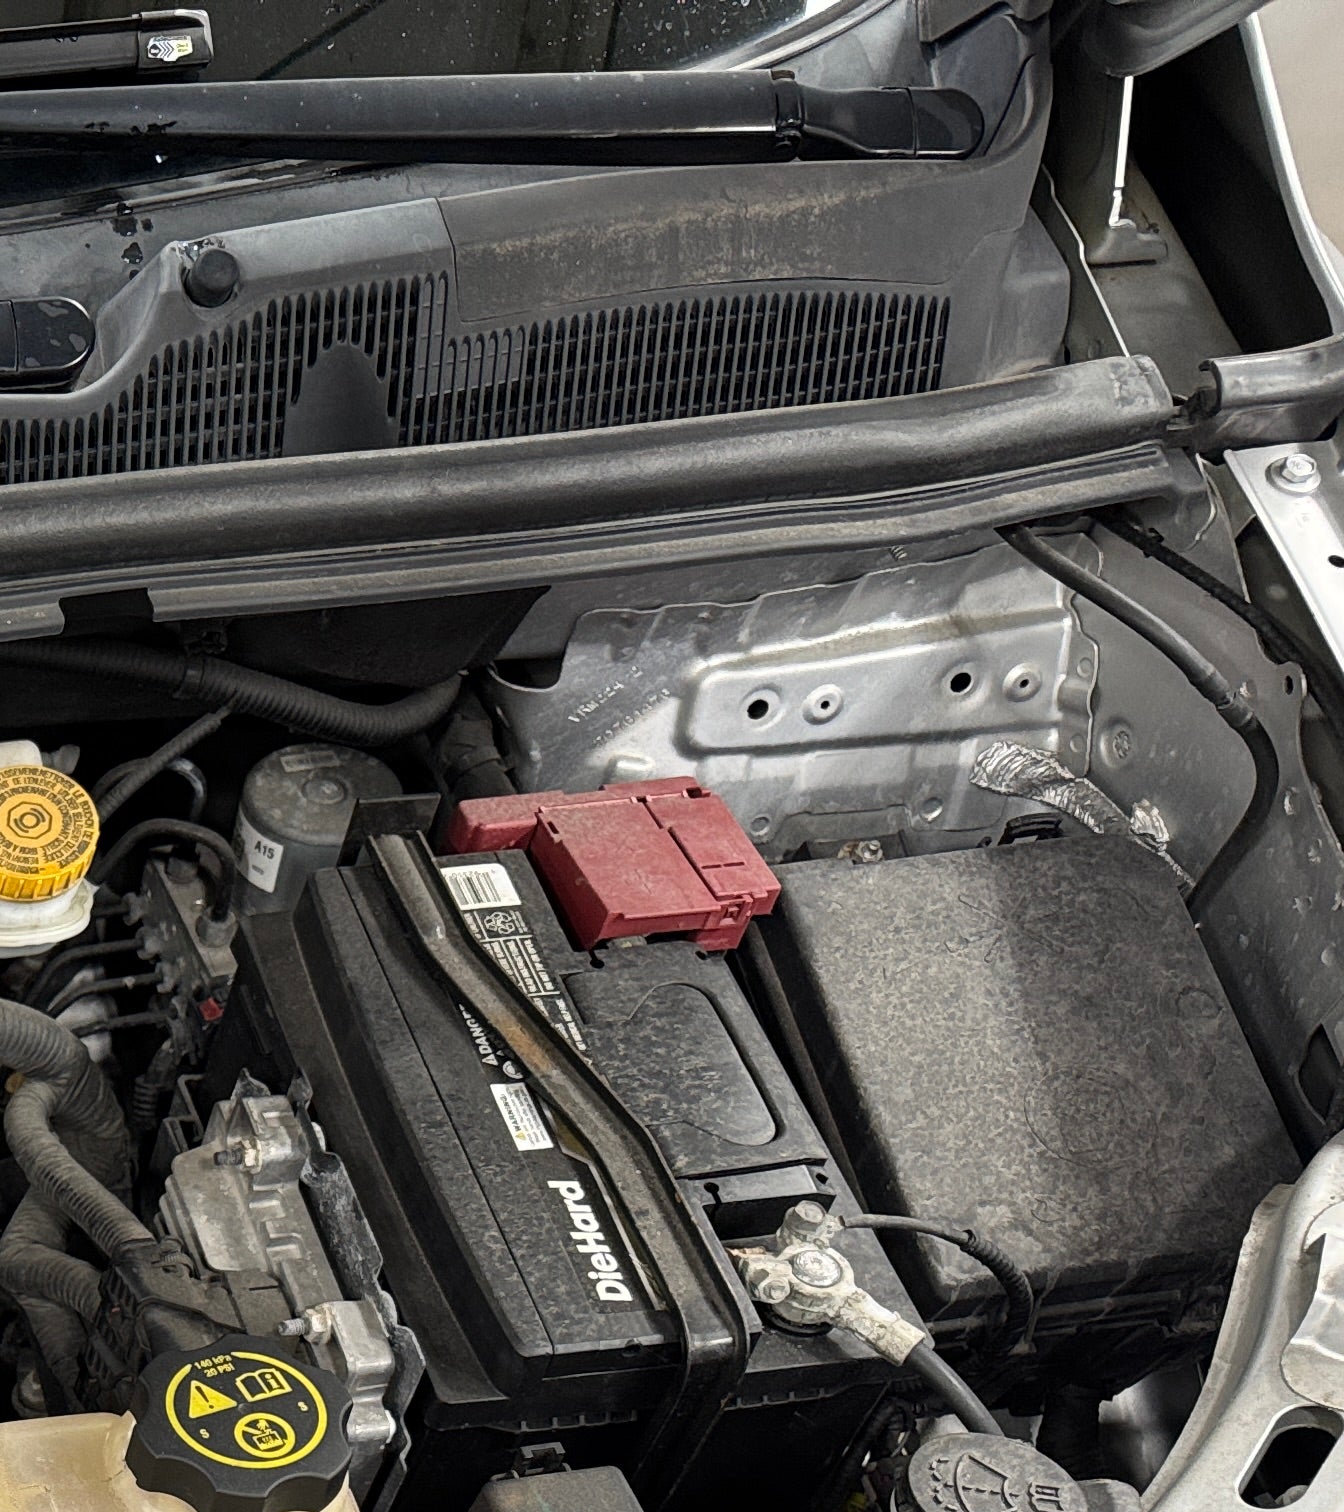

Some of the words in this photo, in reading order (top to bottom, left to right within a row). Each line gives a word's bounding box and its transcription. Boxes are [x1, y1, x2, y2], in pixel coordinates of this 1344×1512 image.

[254, 840, 275, 859] A15
[546, 1180, 633, 1301] DieHard
[194, 1358, 212, 1370] 140
[213, 1354, 232, 1365] kPa
[204, 1366, 218, 1377] 20
[218, 1363, 235, 1375] PSI
